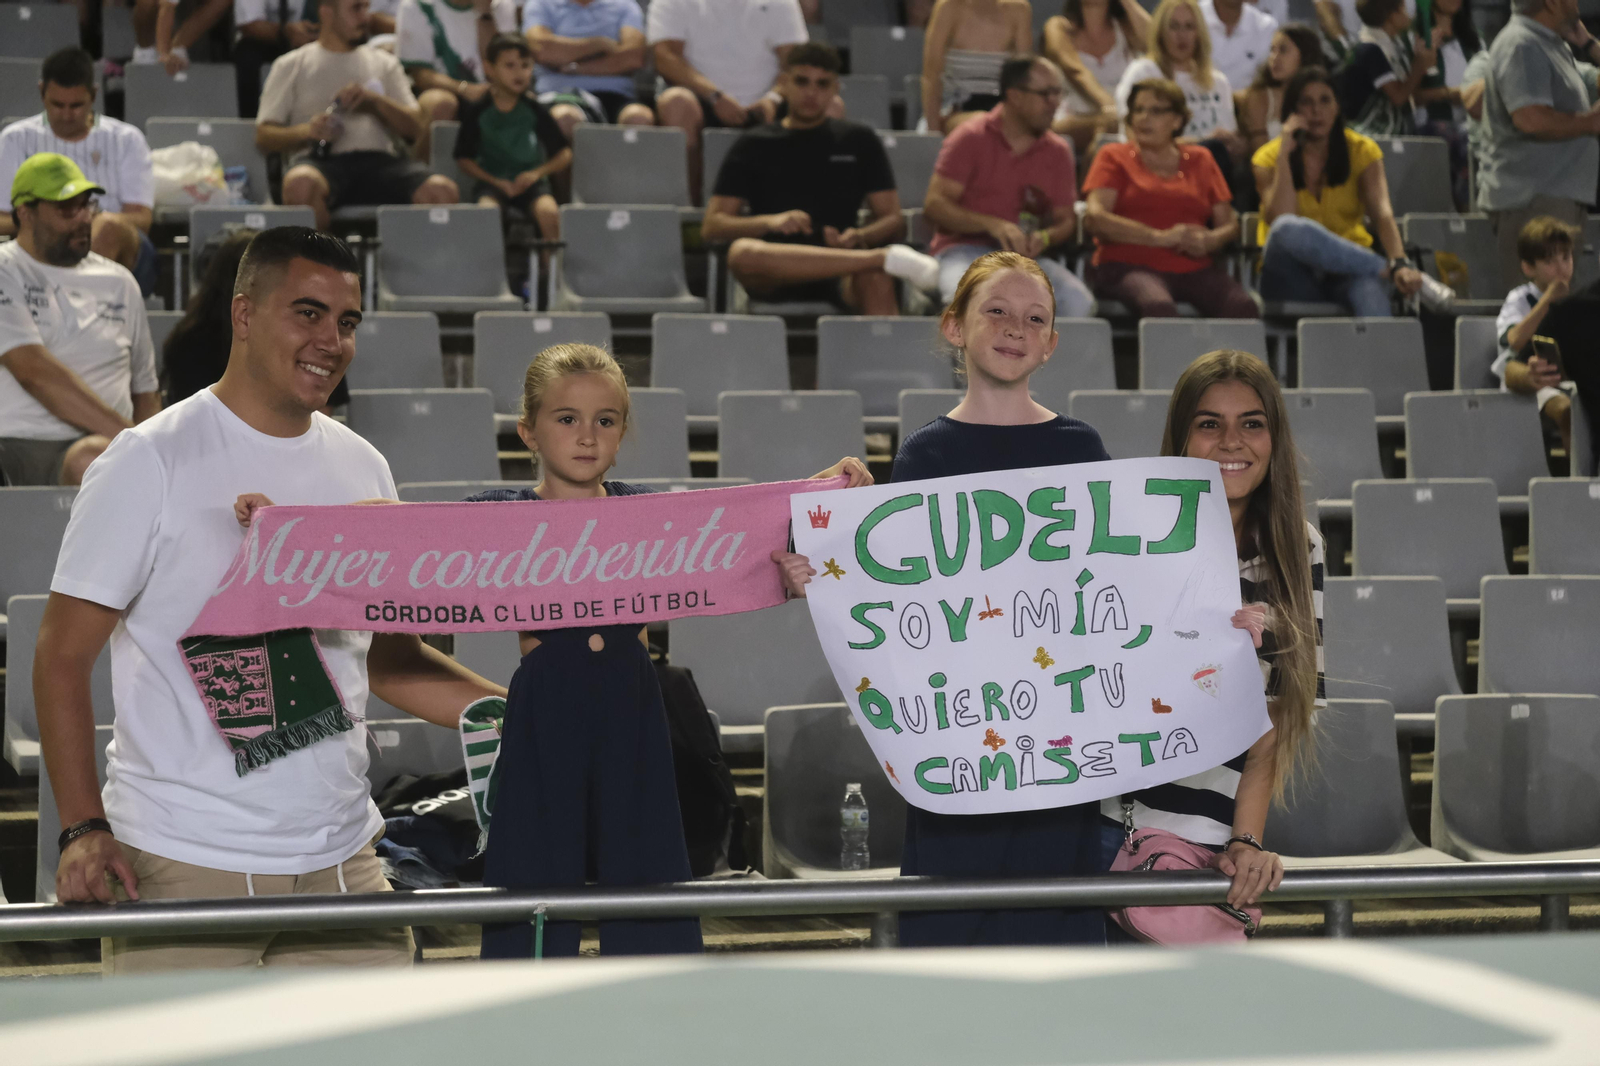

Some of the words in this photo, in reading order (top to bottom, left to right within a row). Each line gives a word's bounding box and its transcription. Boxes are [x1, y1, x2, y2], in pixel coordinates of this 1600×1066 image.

[212, 516, 395, 607] Mujer
[408, 507, 747, 589] cordobesista
[854, 478, 1212, 585] GUDELJ
[494, 603, 563, 622] CLUB
[574, 600, 604, 618] DE
[614, 589, 716, 615] FÚTBOL
[847, 597, 973, 650] SOY
[1013, 568, 1153, 649] MÍA,
[858, 672, 1038, 735] QUIERO
[1054, 663, 1125, 714] TU
[914, 727, 1199, 795] CAMISETA
